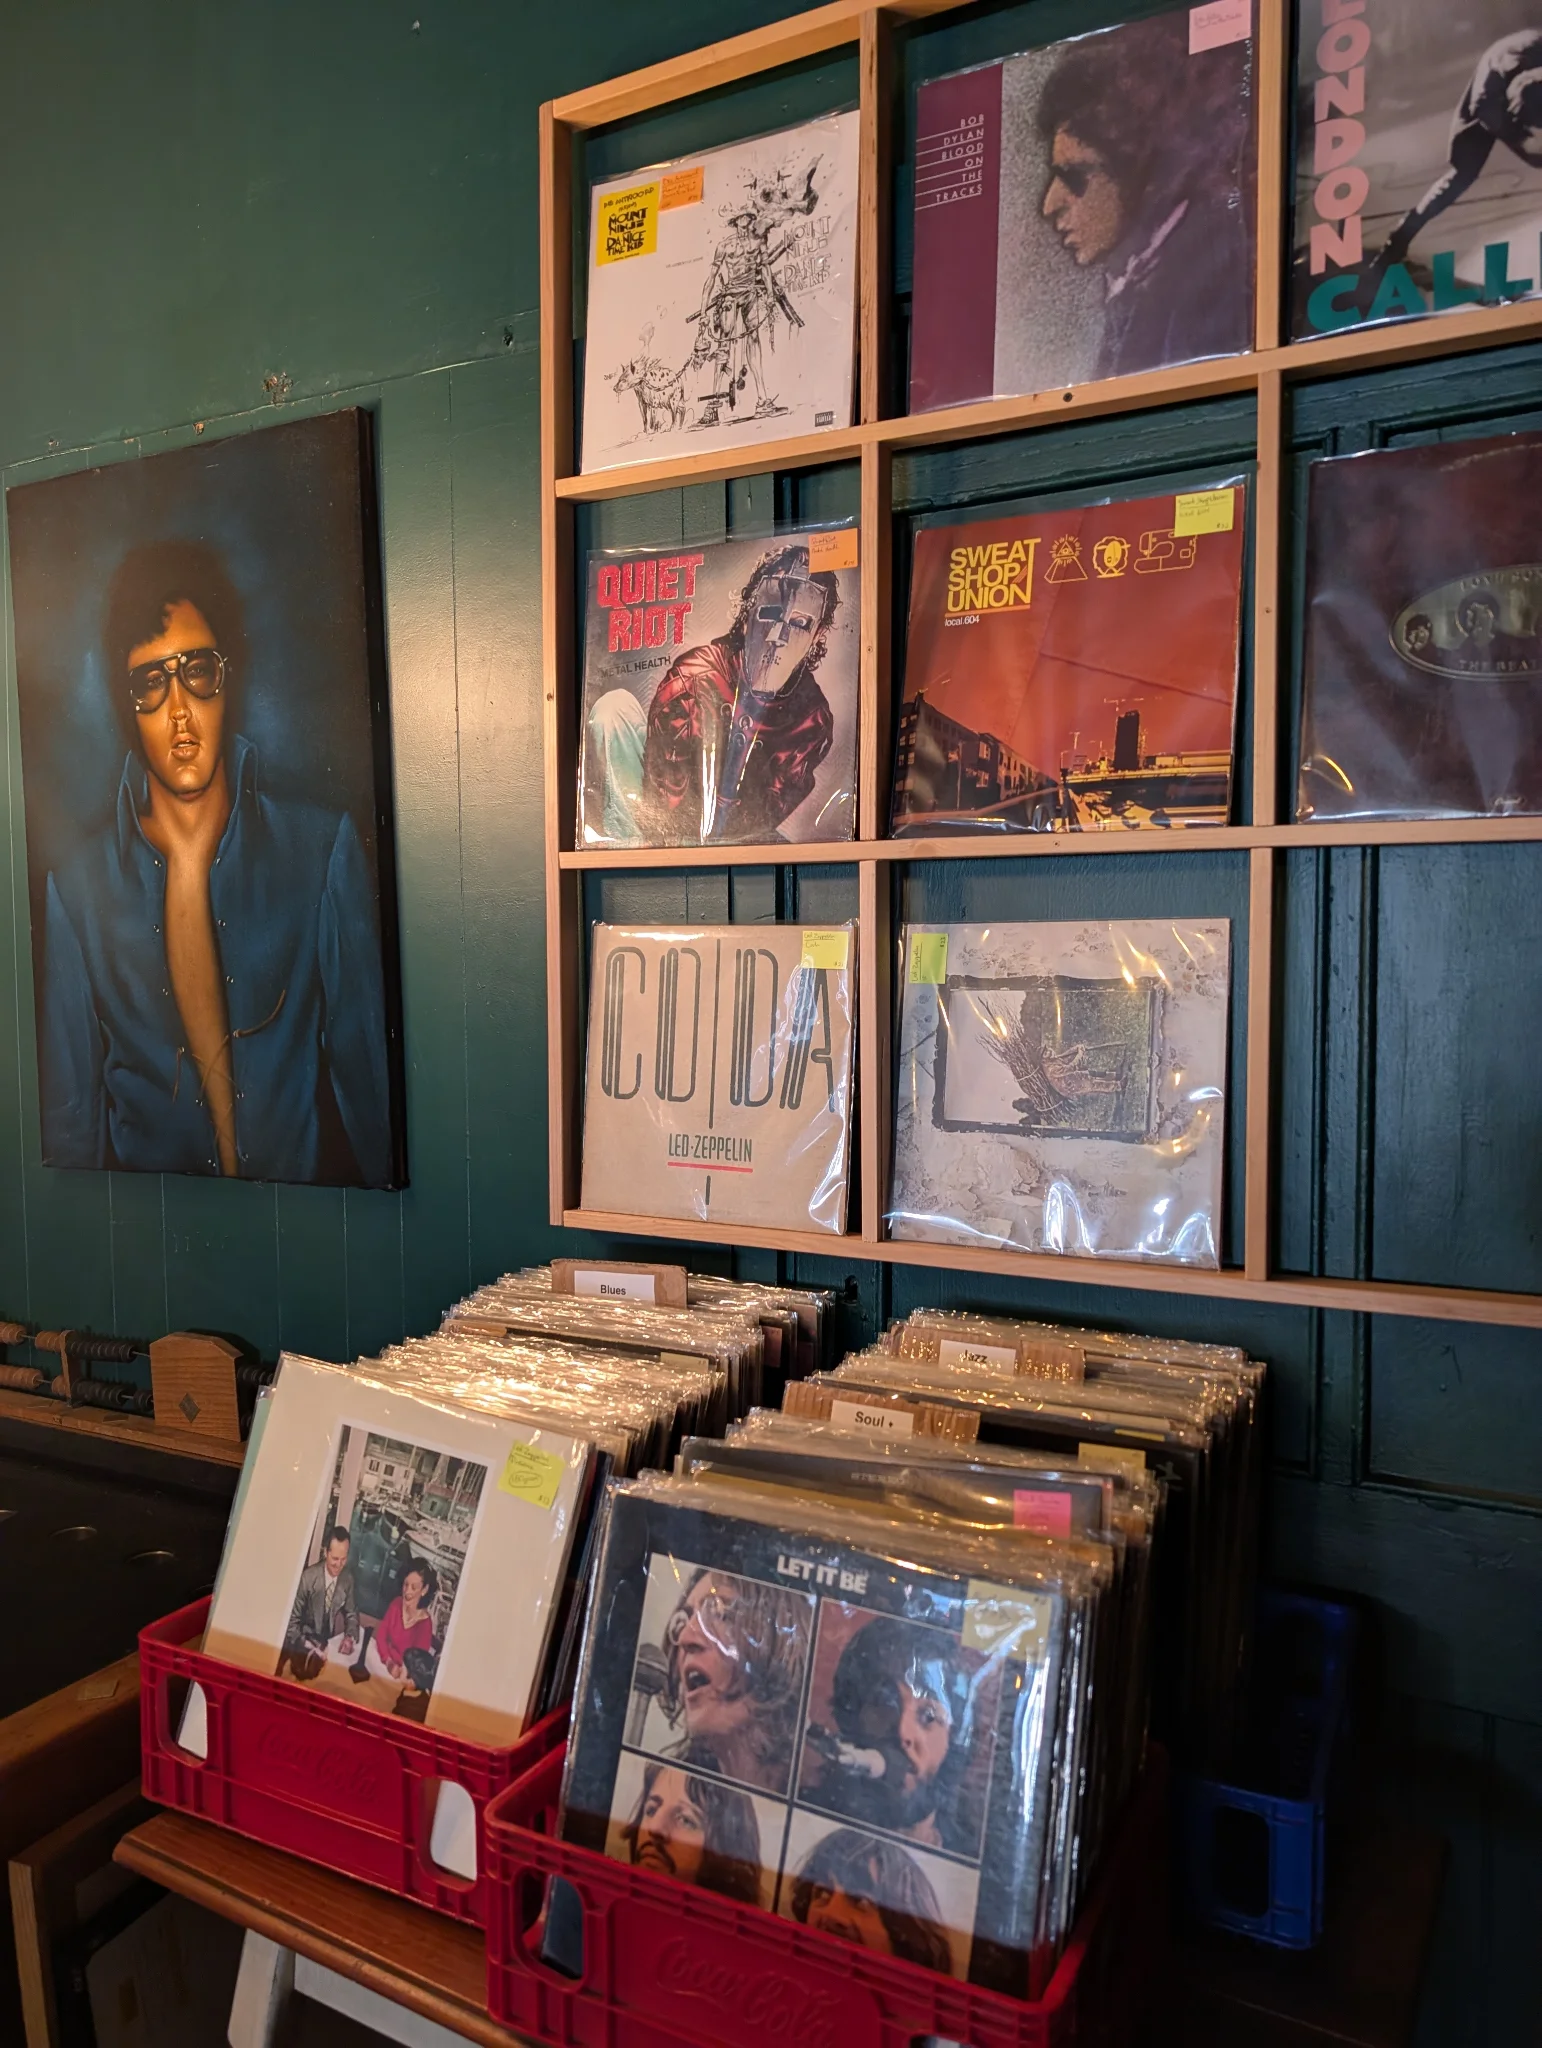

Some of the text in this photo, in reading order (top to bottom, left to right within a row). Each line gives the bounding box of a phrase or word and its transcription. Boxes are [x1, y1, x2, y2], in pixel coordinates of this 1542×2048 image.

[961, 114, 984, 128] BOB
[943, 128, 984, 146] DYLAN
[941, 142, 984, 161] BLOOD
[964, 156, 984, 168] ON
[962, 169, 982, 182] THE
[936, 184, 982, 203] TRACKS
[608, 207, 648, 228] MOUNT
[627, 241, 644, 252] KID
[1308, 231, 1542, 332] CALL
[950, 538, 1041, 582] SWEAT
[597, 553, 704, 609] QUIET
[948, 562, 1021, 591] SHOP
[947, 583, 1031, 612] UNION
[608, 602, 694, 653] RIOT
[944, 615, 980, 627] local.604
[600, 655, 671, 678] METAL HEALTH
[601, 946, 834, 1113] CODA
[600, 1284, 627, 1296] Blues
[964, 1349, 988, 1364] Jazz
[854, 1411, 885, 1428] Soul
[777, 1554, 869, 1595] LET IT BE
